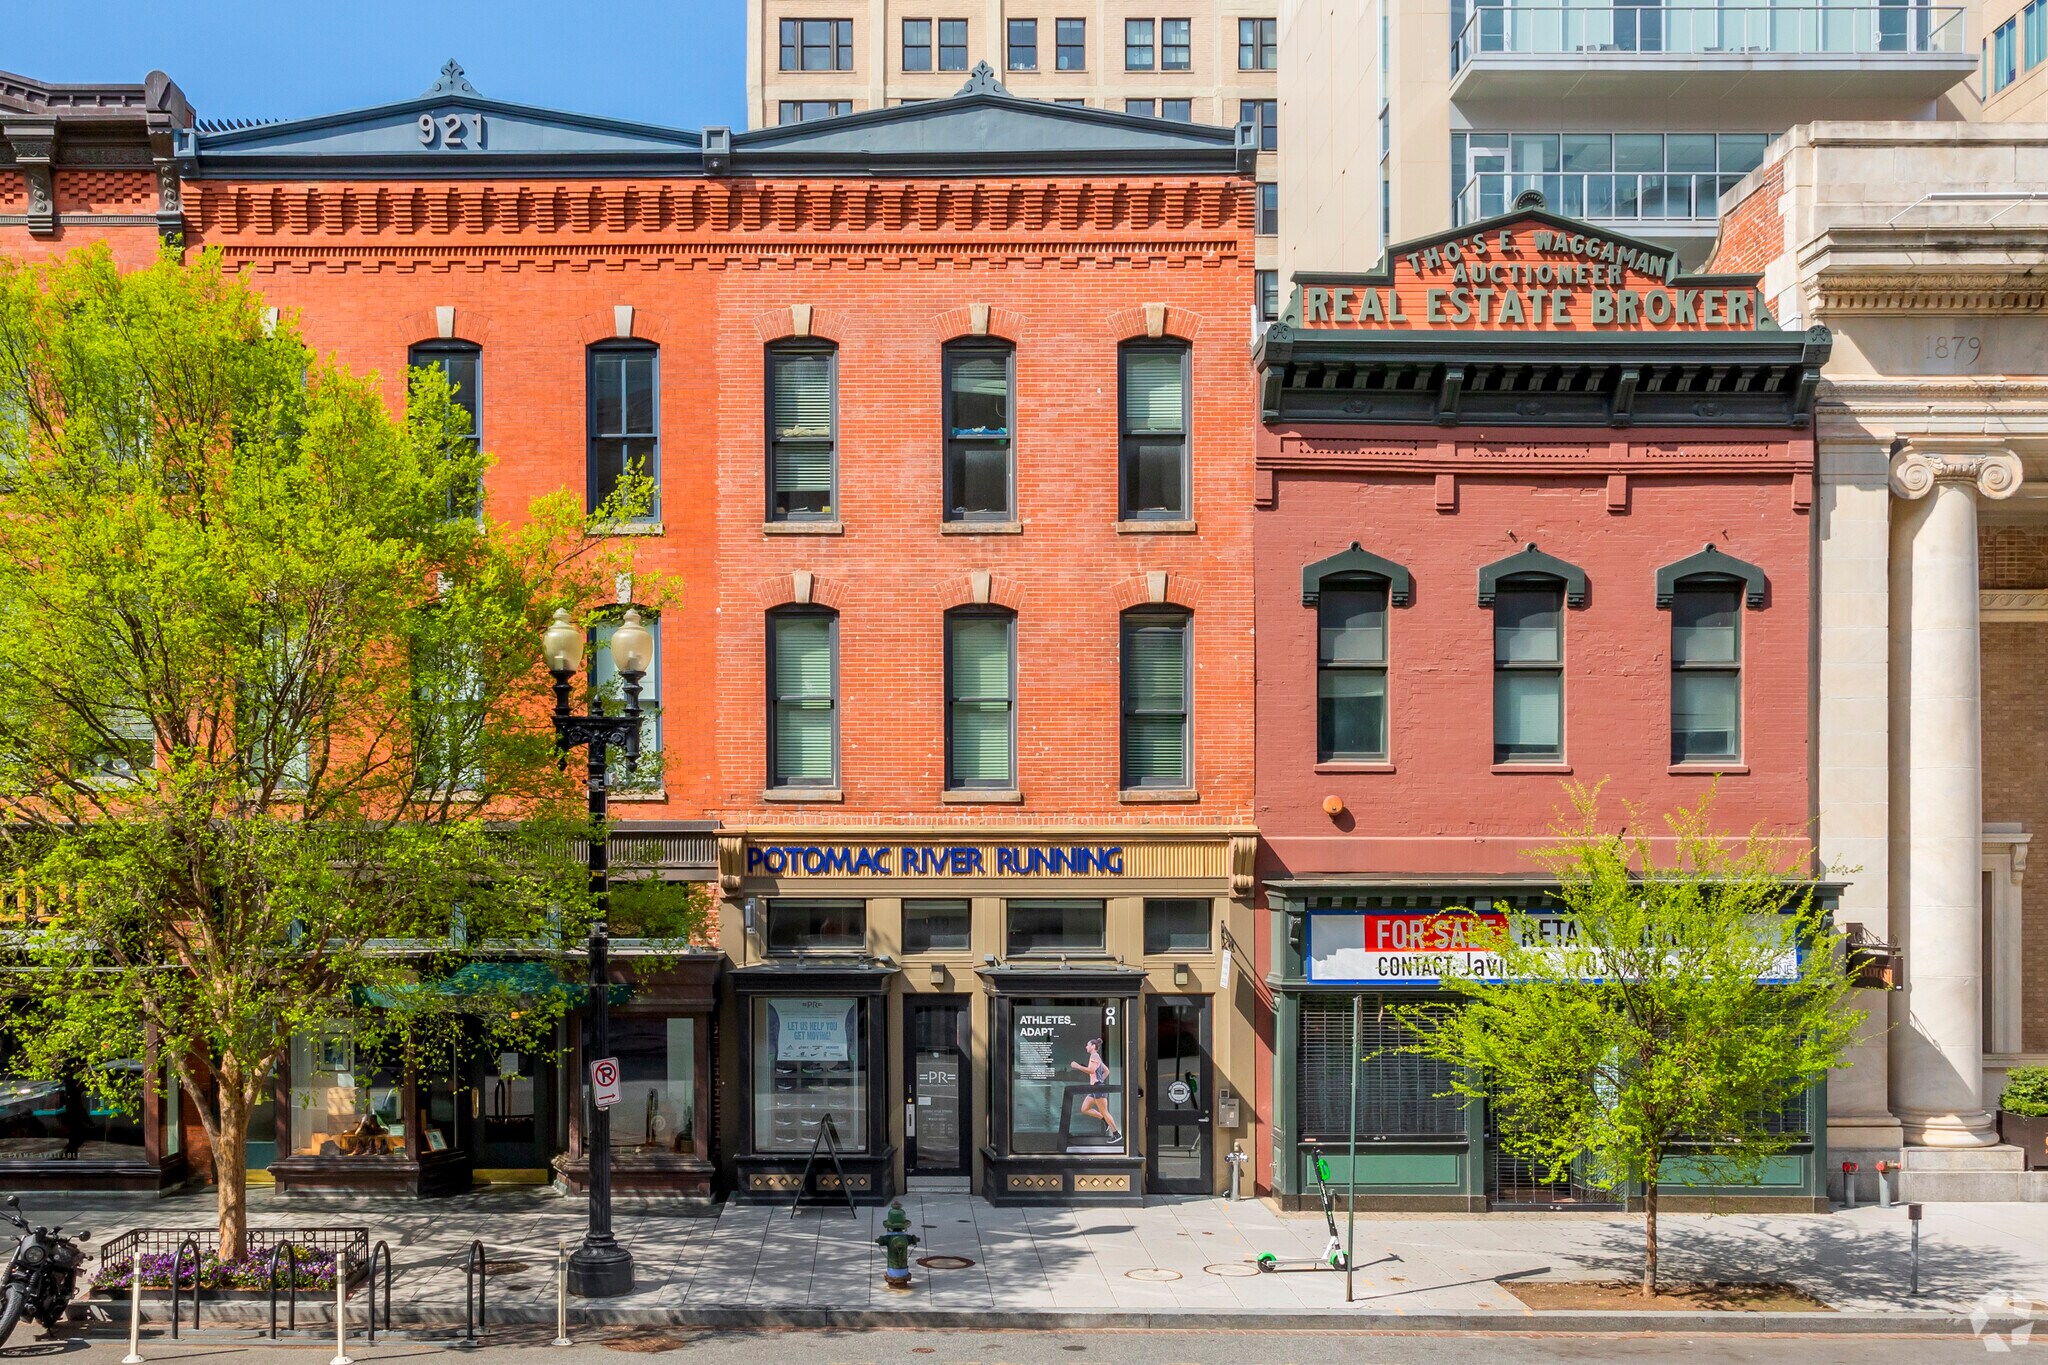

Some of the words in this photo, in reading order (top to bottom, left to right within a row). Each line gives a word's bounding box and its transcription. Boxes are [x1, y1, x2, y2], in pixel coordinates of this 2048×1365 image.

[418, 113, 481, 143] 921
[1406, 233, 1487, 273] THO'S
[1500, 230, 1519, 251] E.
[1532, 230, 1666, 277] WAGGAMAN
[1452, 263, 1622, 284] AUCTIONEER
[1308, 287, 1407, 323] REAL
[1427, 287, 1572, 324] ESTATE
[1591, 289, 1749, 324] BROKER
[1926, 336, 1982, 366] 1879
[747, 847, 891, 874] POTOMAC
[902, 847, 985, 874] RIVER
[996, 847, 1123, 875] RUNNING
[1377, 919, 1425, 949] FOR
[787, 1021, 798, 1031] LET
[800, 1021, 808, 1031] US
[809, 1021, 825, 1031] HELP
[825, 1021, 838, 1031] YOU
[794, 1031, 805, 1040] GET
